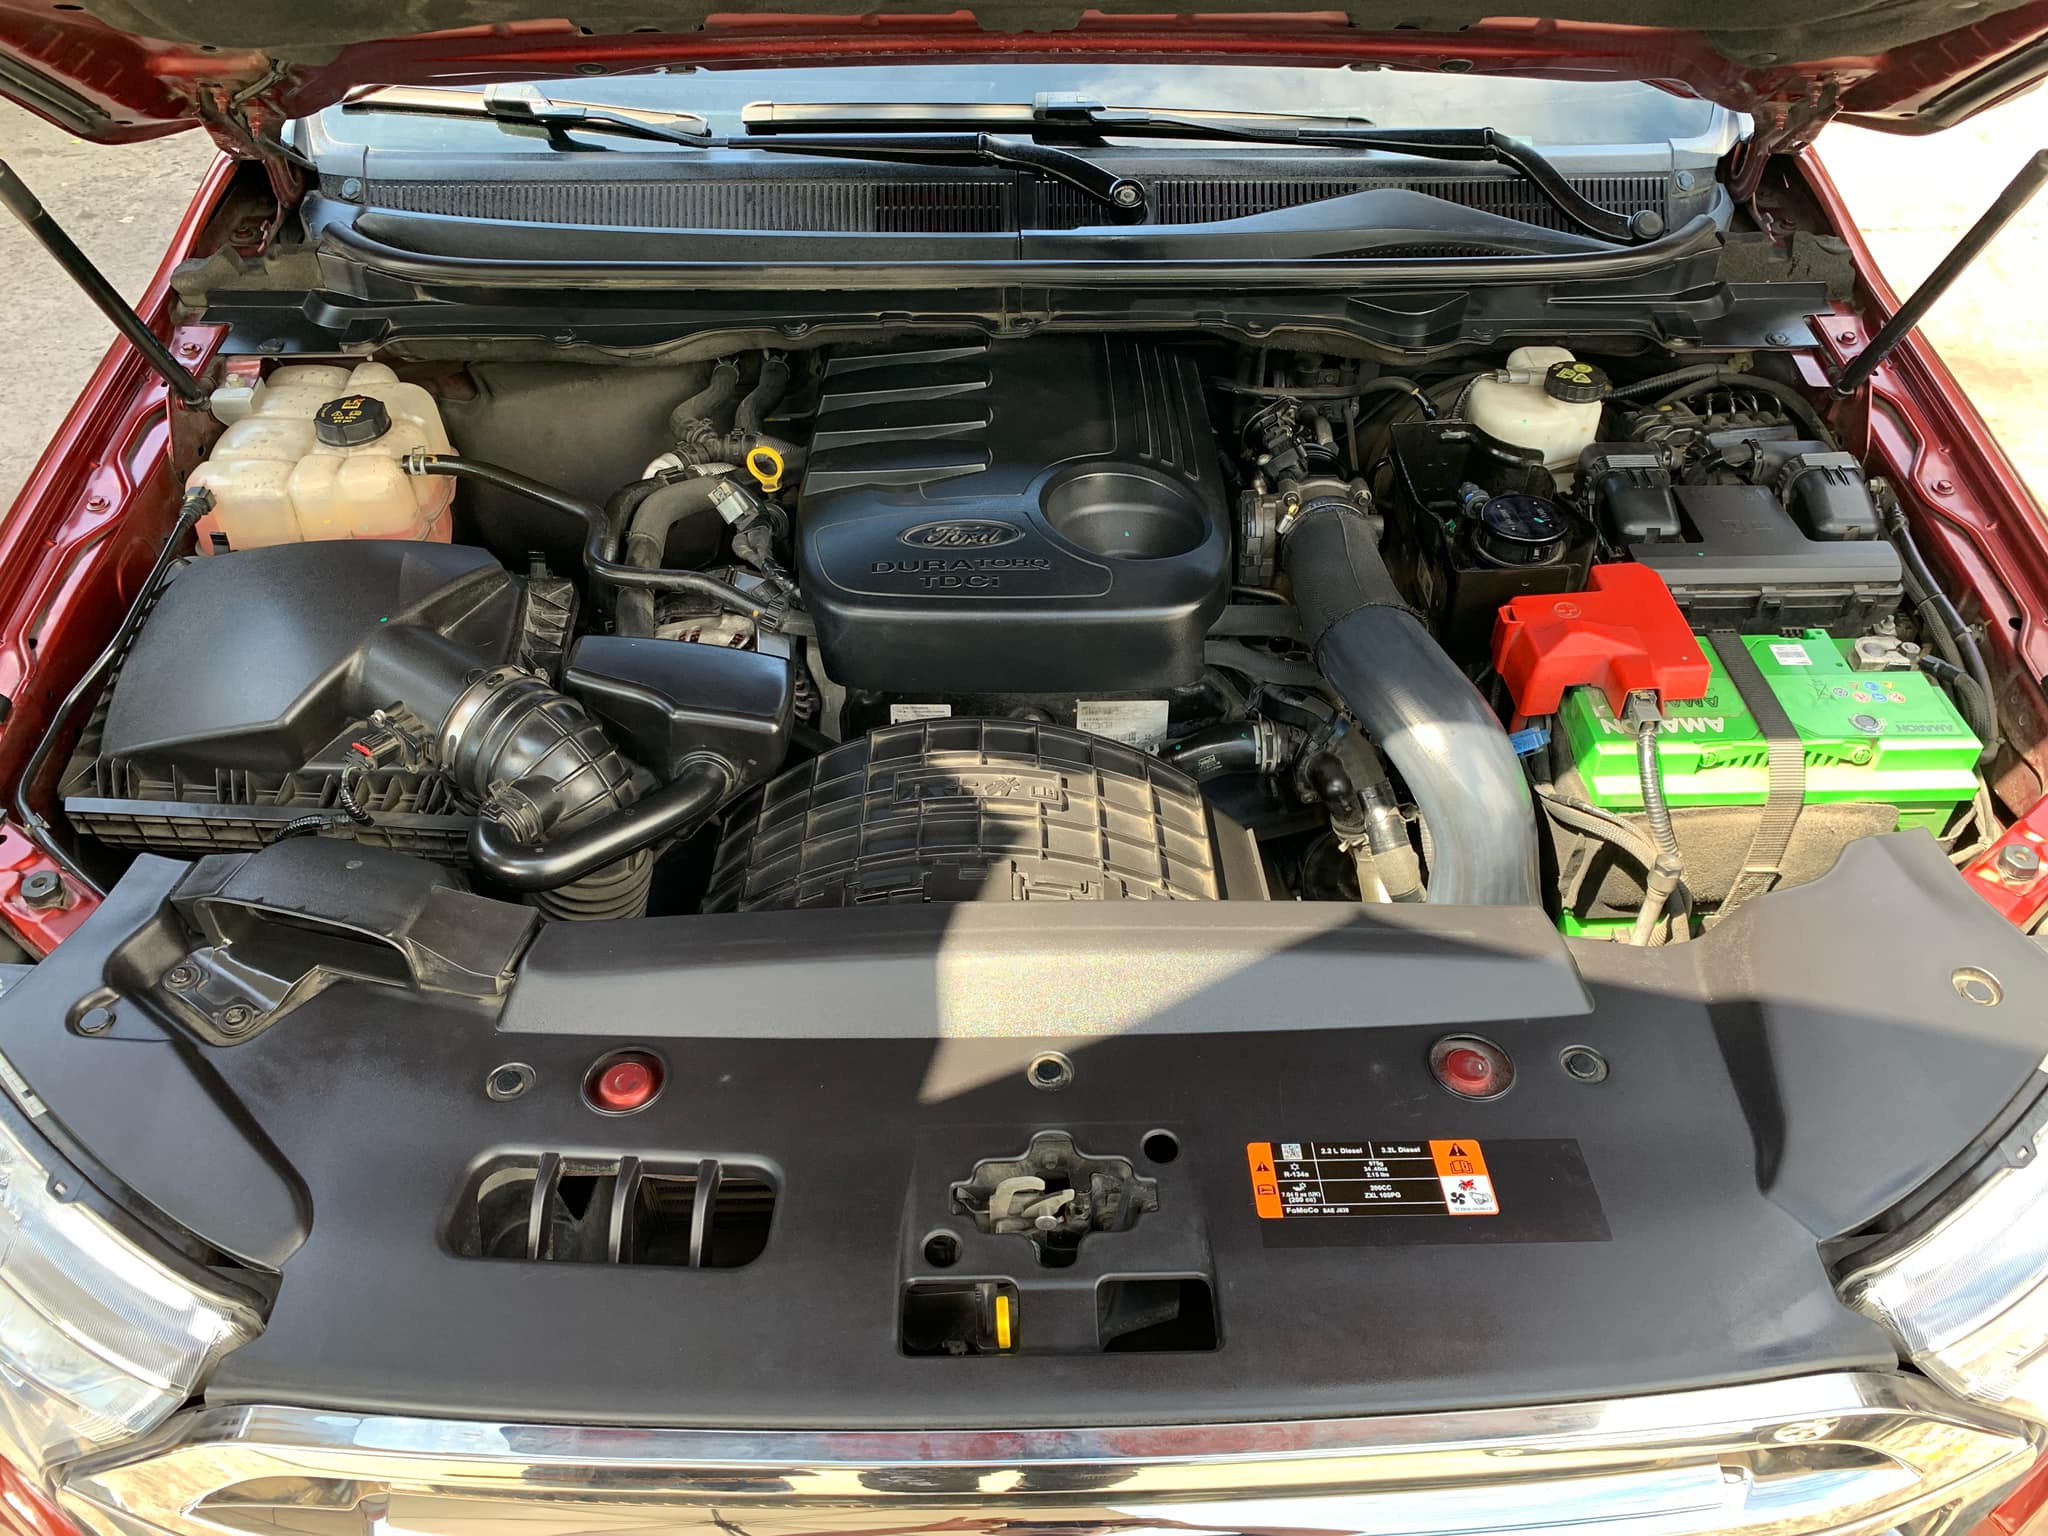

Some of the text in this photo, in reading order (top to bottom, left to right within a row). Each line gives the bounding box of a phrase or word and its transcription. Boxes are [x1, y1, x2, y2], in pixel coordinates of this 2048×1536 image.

[926, 525, 1001, 547] Ford
[871, 559, 1051, 574] DURATORQ
[919, 575, 1000, 589] TDCi
[1600, 717, 1725, 734] AMAON
